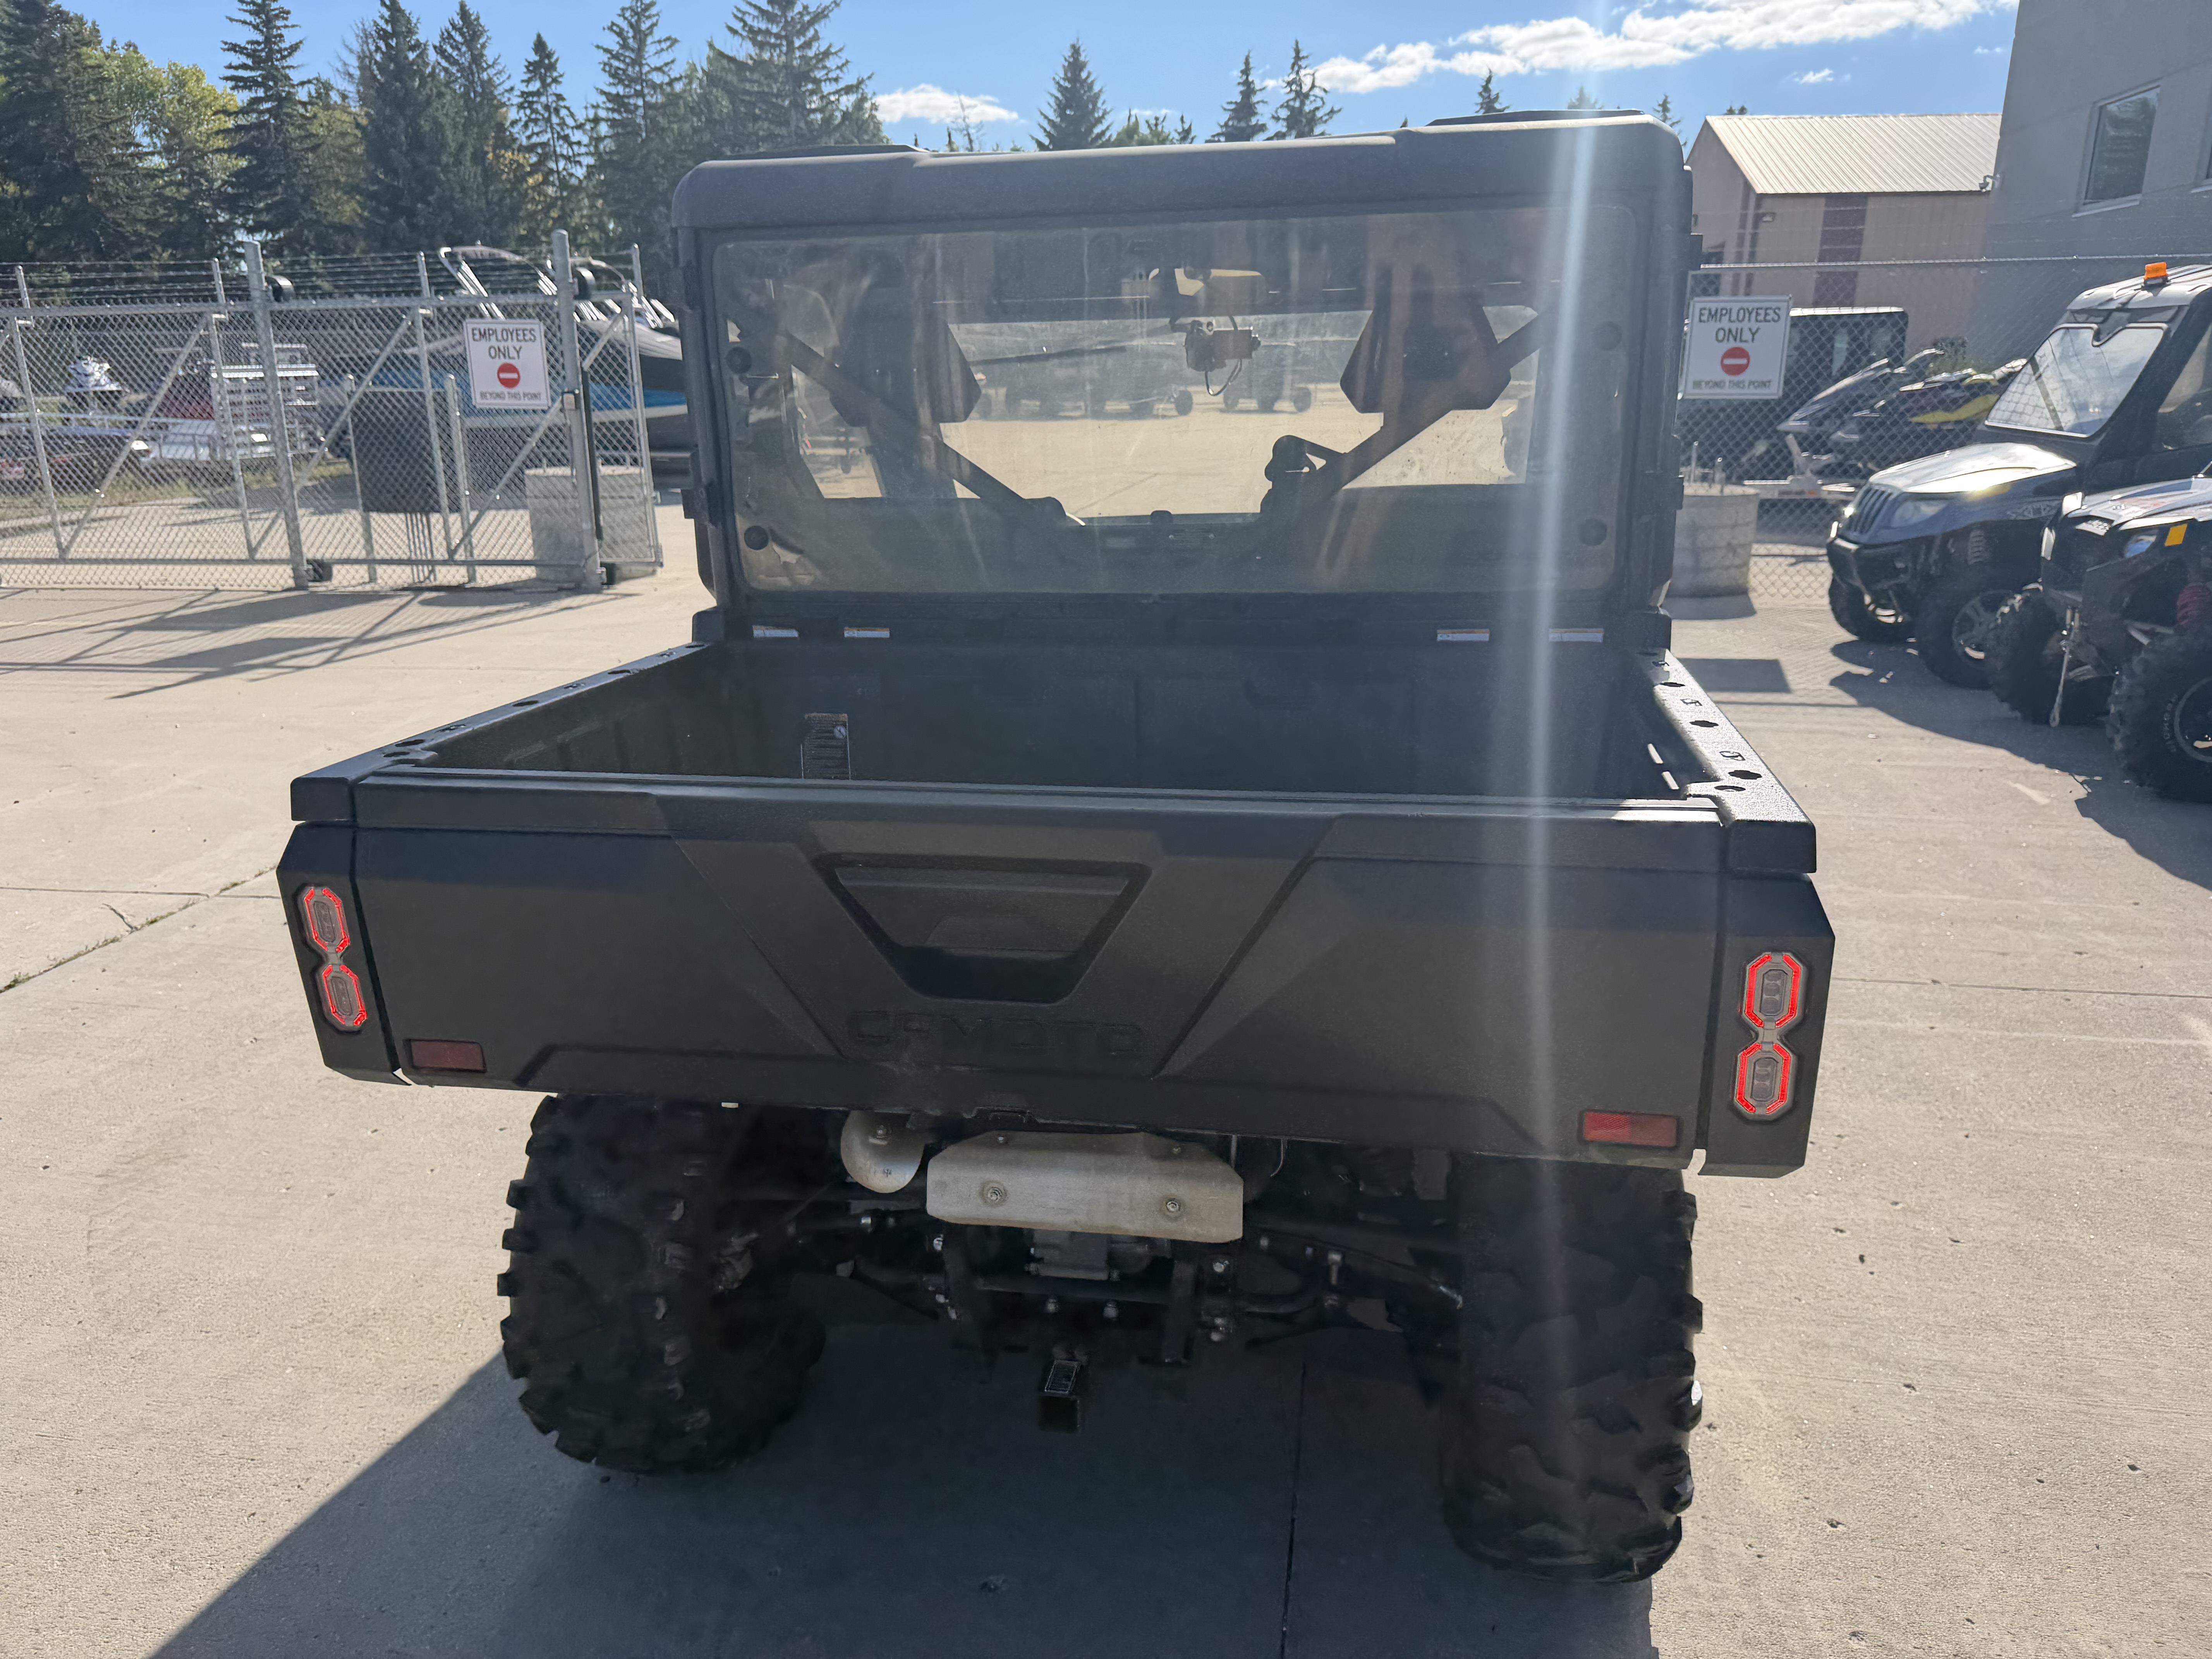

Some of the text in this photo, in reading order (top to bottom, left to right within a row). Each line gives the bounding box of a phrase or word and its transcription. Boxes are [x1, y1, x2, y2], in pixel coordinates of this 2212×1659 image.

[1698, 307, 1781, 323] EMPLOYEES
[471, 327, 537, 343] EMPLOYEES
[1715, 326, 1761, 343] ONLY
[488, 345, 522, 360] ONLY
[1692, 379, 1725, 389] EYOND
[479, 391, 541, 401] BEYOND THIS POINT
